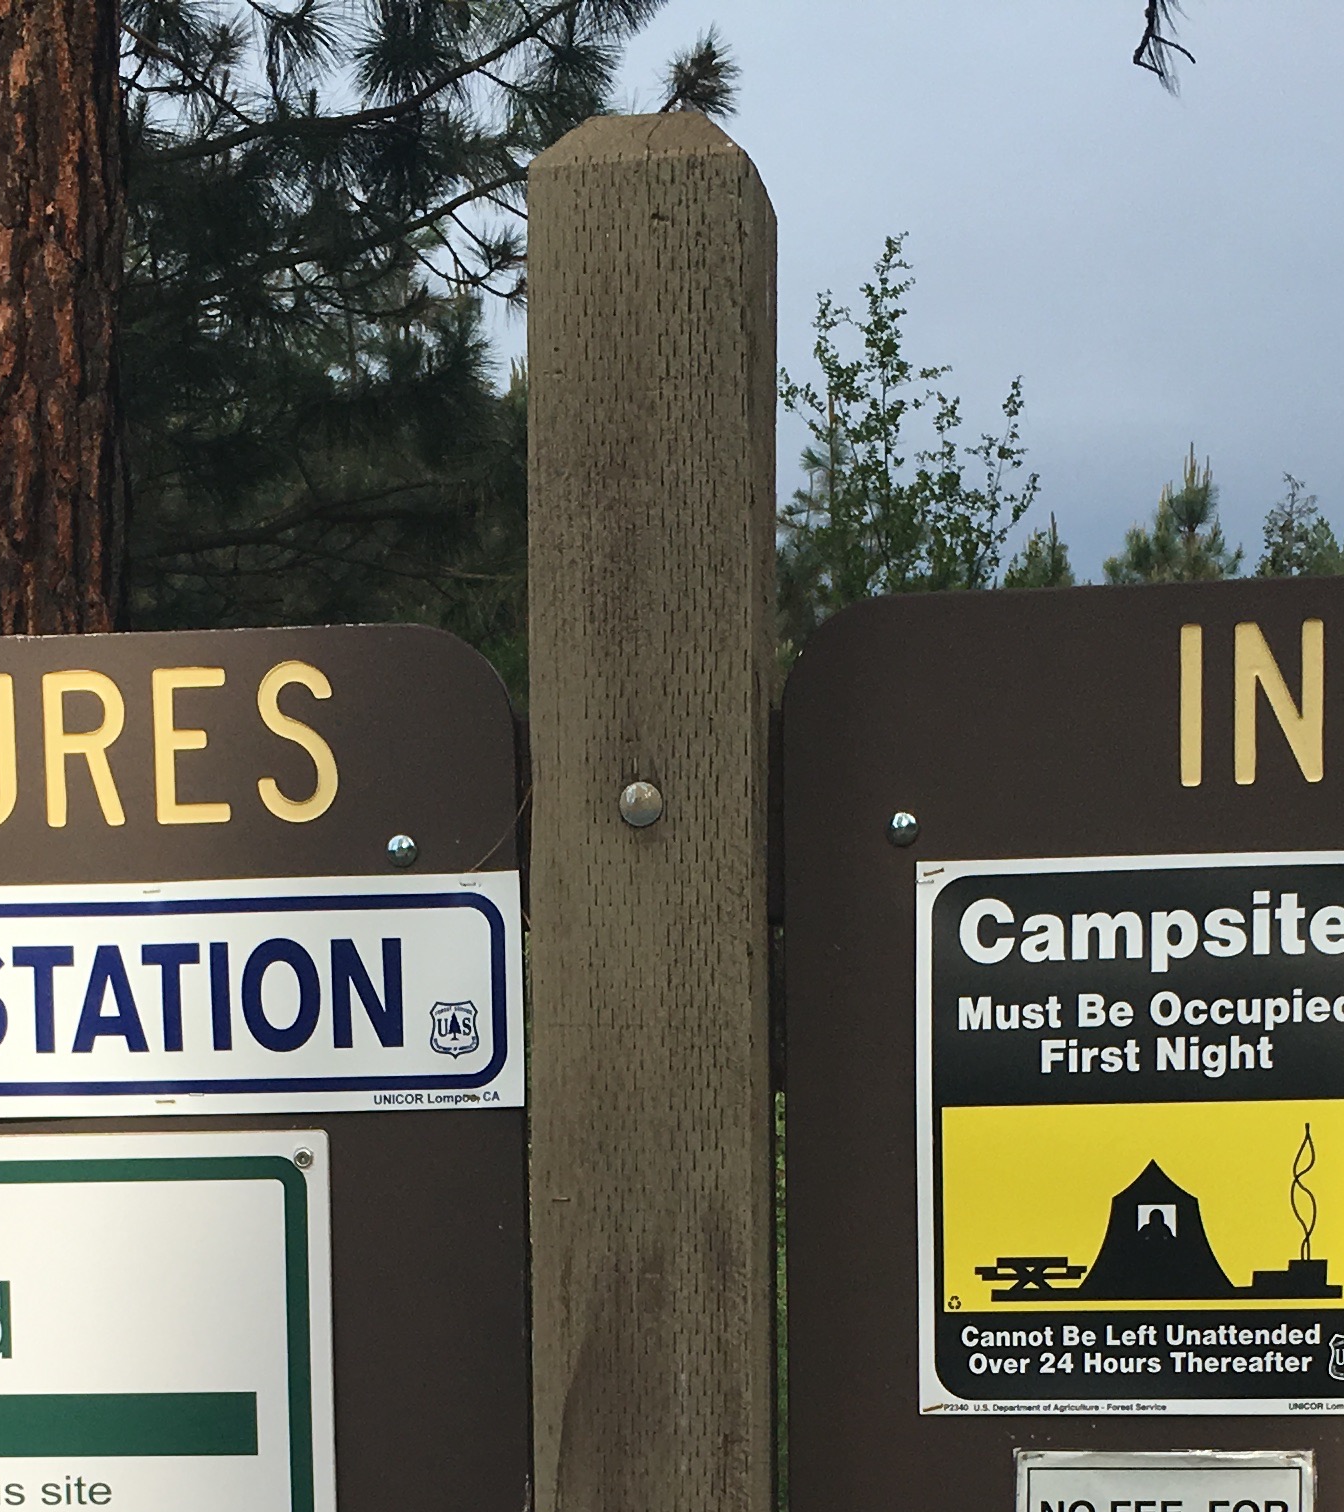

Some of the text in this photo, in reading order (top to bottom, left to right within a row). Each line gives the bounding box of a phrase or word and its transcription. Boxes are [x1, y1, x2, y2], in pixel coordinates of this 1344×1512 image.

[958, 995, 1062, 1031] Must
[1077, 993, 1134, 1028] Be
[1040, 1035, 1274, 1078] First Night
[961, 1323, 1321, 1348] Cannot Be Left Unattended
[968, 1350, 1313, 1375] Over 24 Hours Thereafter
